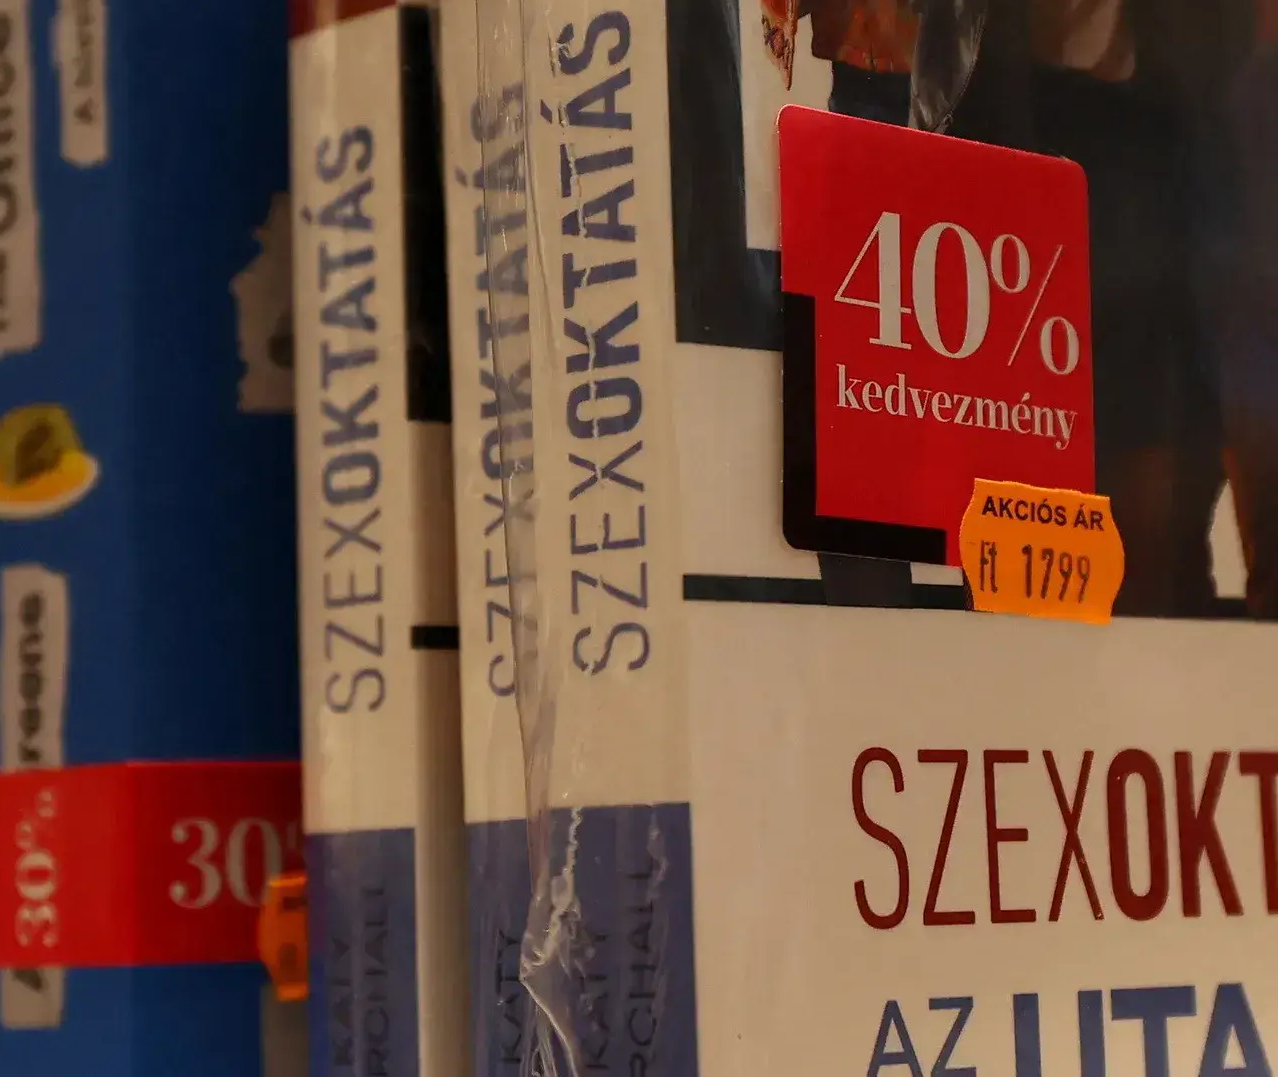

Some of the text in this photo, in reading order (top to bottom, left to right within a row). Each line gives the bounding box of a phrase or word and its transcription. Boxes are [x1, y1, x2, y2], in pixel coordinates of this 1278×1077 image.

[834, 210, 1081, 376] 40%
[539, 10, 651, 676] SZEXOKTATÁS
[300, 125, 386, 716] SZEXOKTATÁS
[835, 363, 1078, 450] kedvezmény
[981, 494, 1105, 532] AKCIÓS ÁR
[1021, 540, 1092, 604] 1799
[168, 817, 305, 909] 30
[865, 994, 978, 1077] AZ
